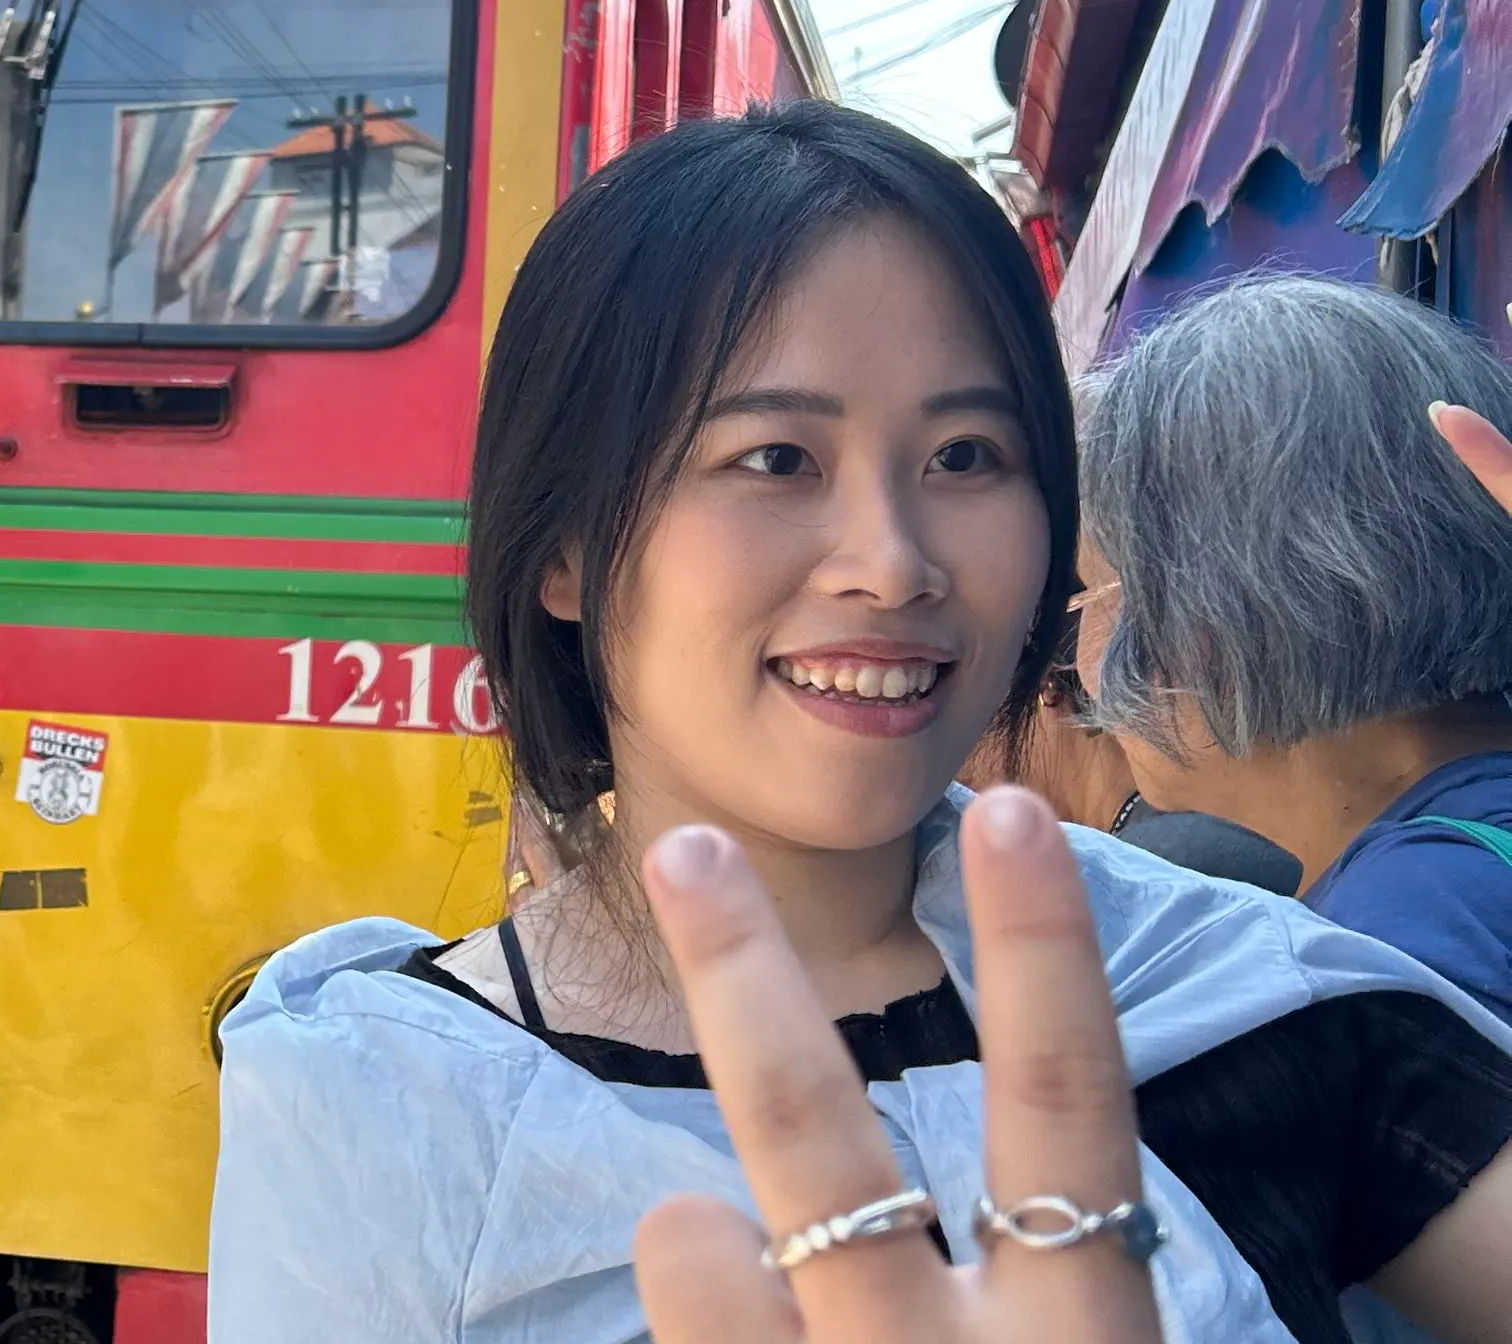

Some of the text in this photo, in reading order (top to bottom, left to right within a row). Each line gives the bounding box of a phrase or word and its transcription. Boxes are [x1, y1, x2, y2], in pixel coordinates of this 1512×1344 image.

[275, 637, 504, 733] 1216
[30, 725, 105, 752] DRECKS
[30, 740, 99, 763] BULLEN
